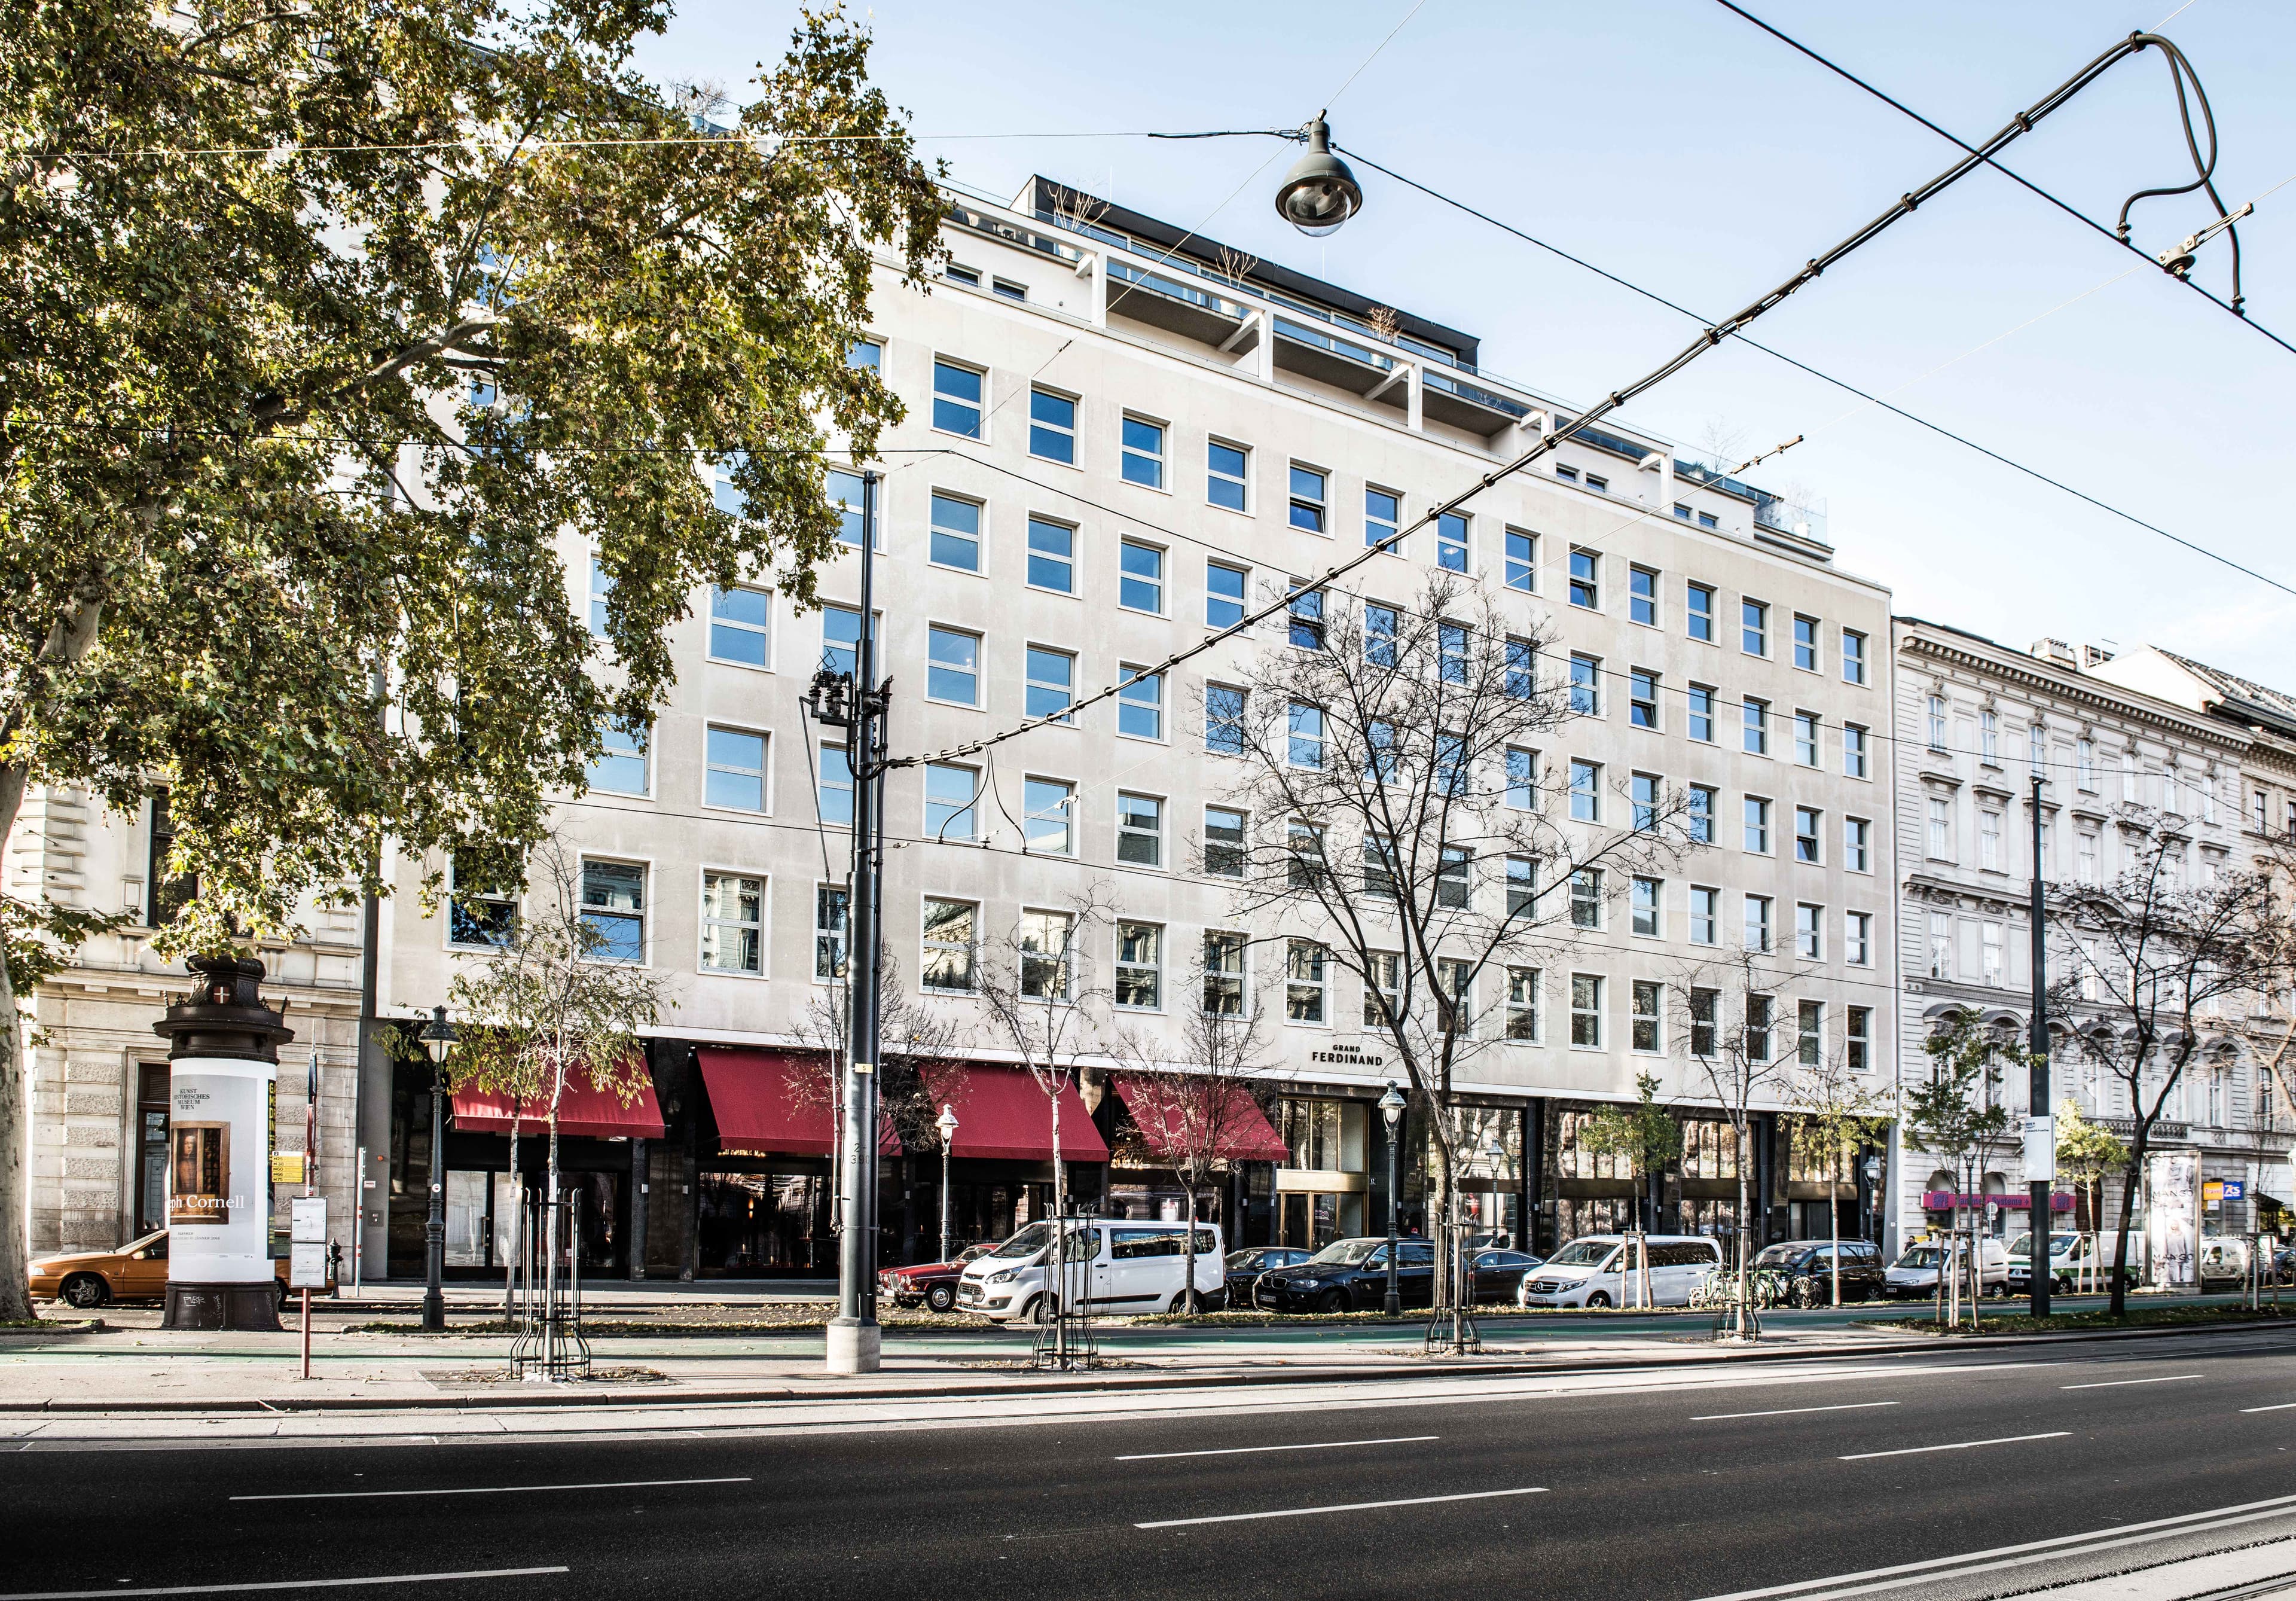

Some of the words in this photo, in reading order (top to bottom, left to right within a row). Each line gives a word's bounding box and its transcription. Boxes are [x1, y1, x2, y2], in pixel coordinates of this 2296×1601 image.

[1312, 1052, 1382, 1066] FERDINAND
[851, 1155, 870, 1164] 390
[186, 1195, 245, 1209] Cornell
[1992, 1197, 2022, 1206] Systeme
